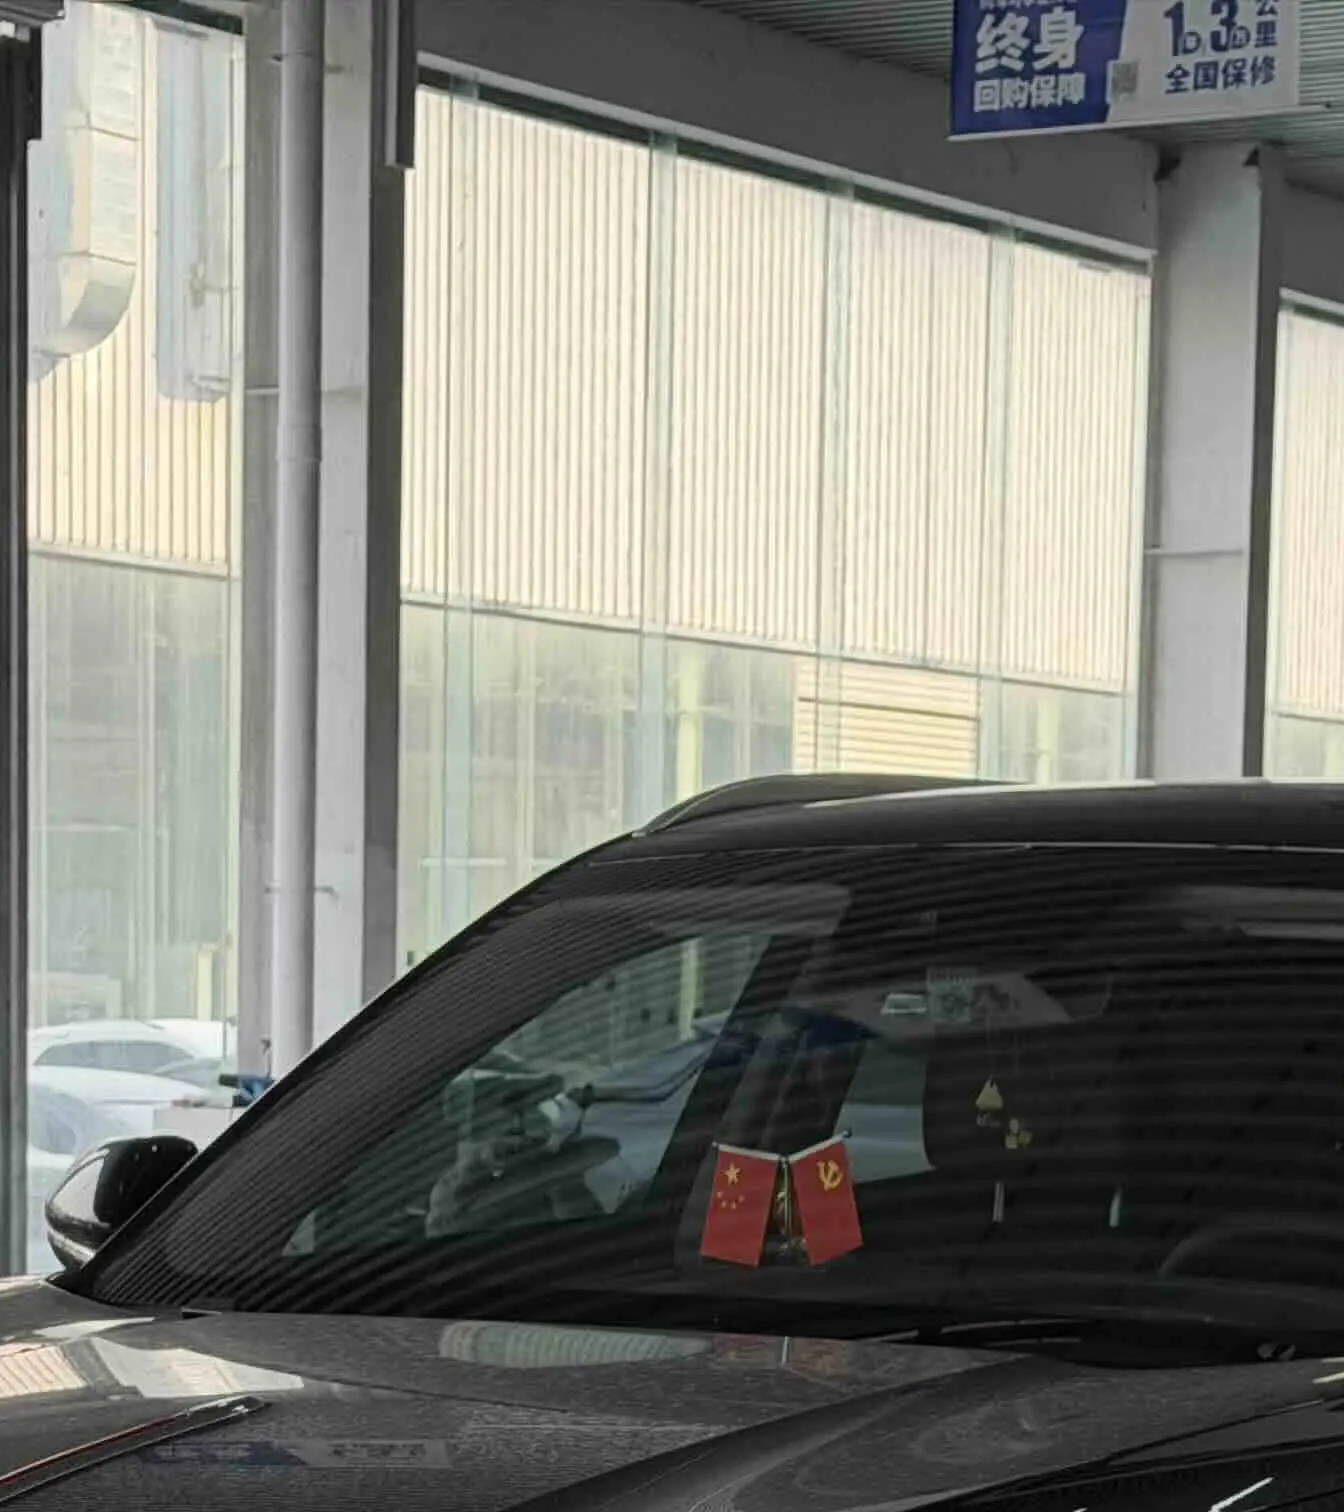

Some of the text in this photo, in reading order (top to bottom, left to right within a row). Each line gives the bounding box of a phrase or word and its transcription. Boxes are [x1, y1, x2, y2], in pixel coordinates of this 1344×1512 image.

[975, 6, 1084, 74] 终身
[972, 73, 1086, 113] 回购保障
[1165, 55, 1276, 95] 全国保修
